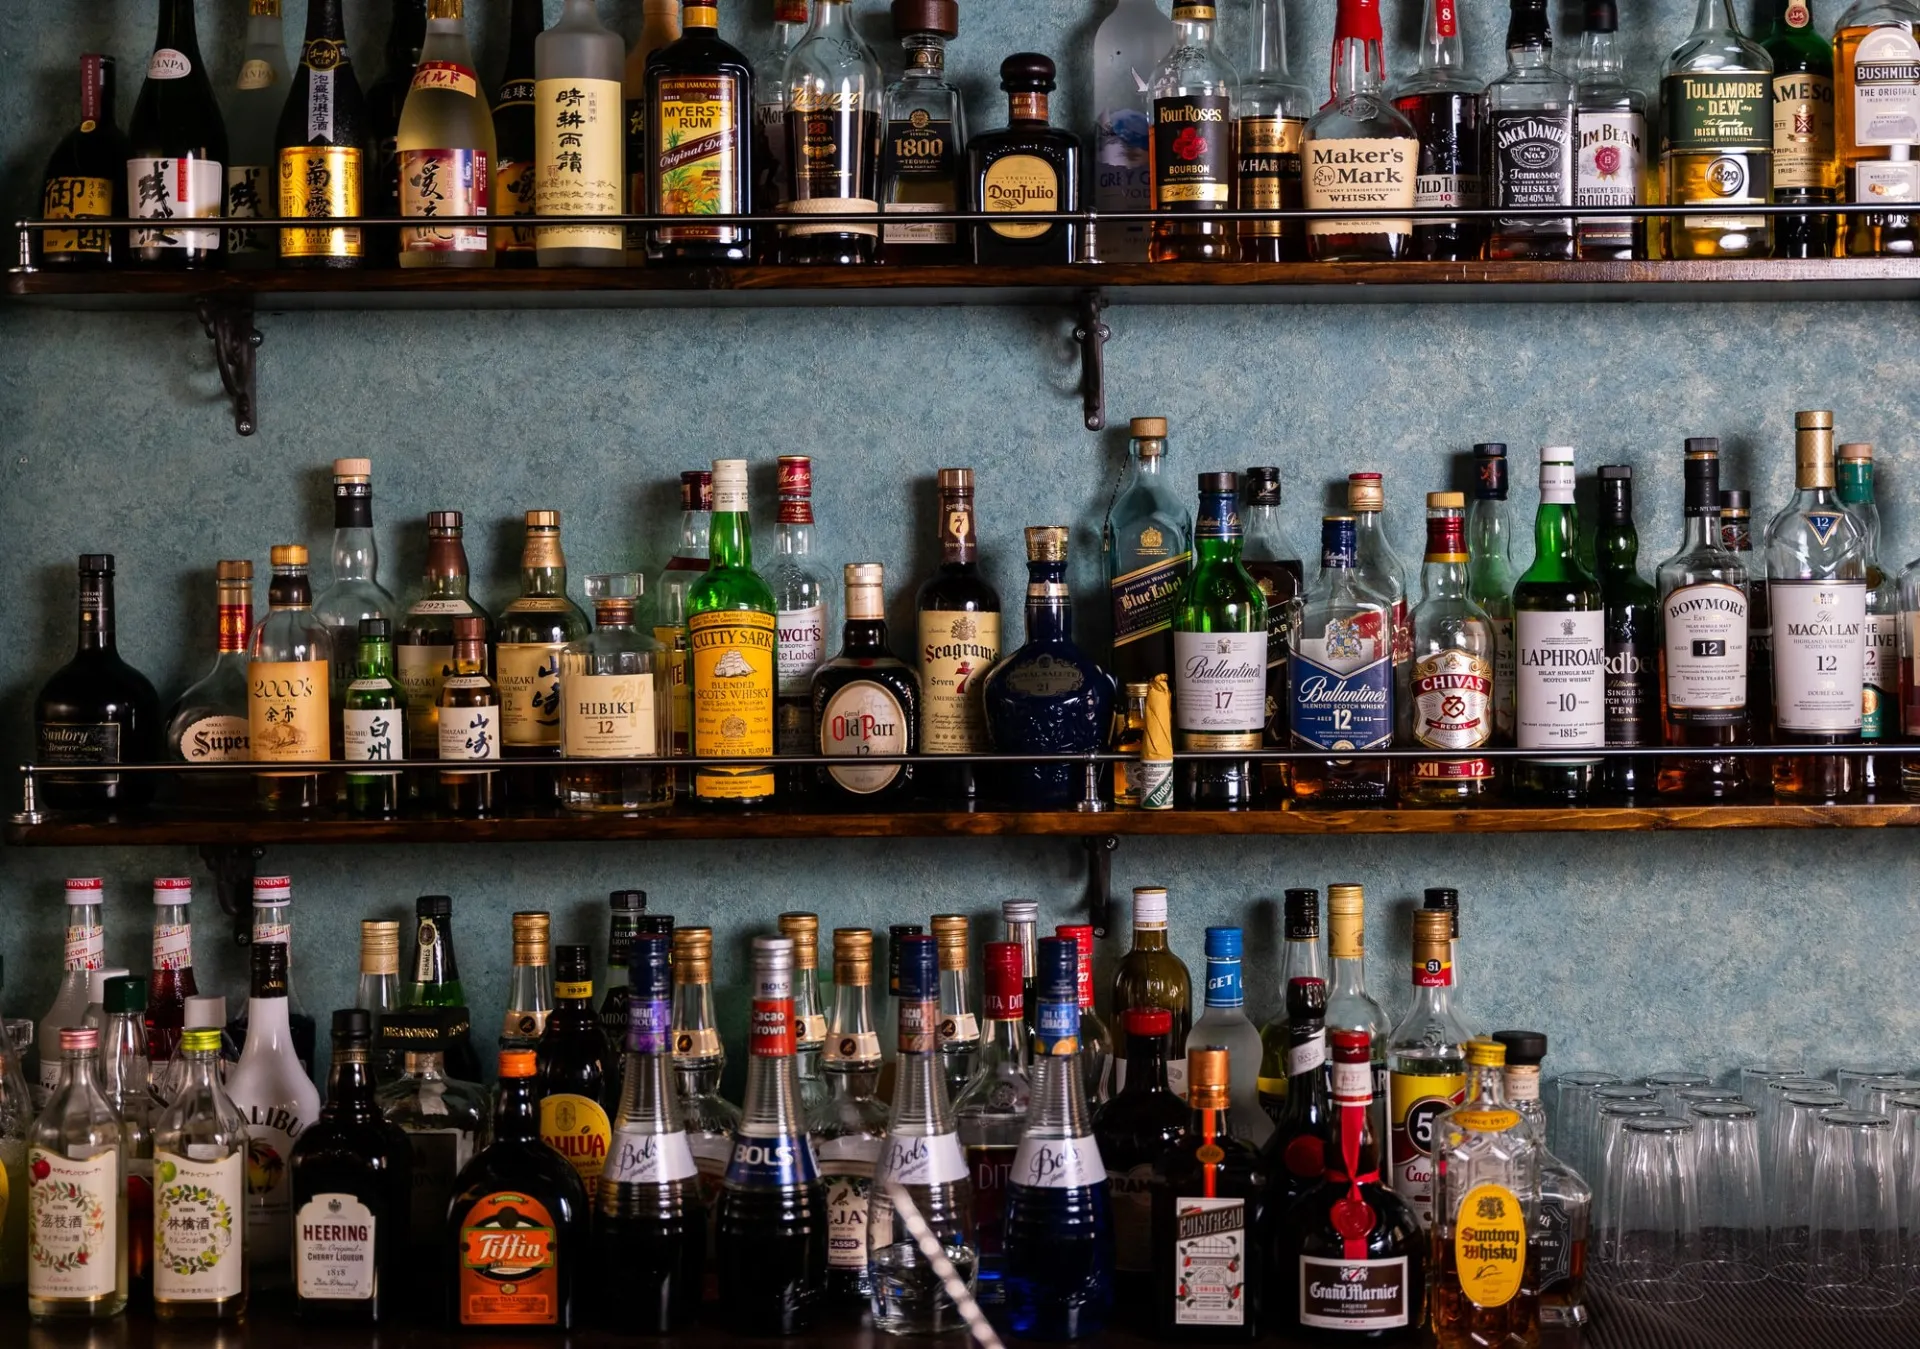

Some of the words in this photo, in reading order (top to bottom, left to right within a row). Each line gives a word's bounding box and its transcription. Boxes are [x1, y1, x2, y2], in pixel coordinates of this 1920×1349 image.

[1442, 8, 1451, 21] 8
[1857, 66, 1920, 80] BUSHMILLS
[1683, 79, 1764, 100] TULLAMORE
[1773, 82, 1832, 104] AMESO
[1860, 88, 1875, 97] THE
[1879, 88, 1917, 97] ORIGINAL
[664, 105, 731, 117] MYERS'S
[762, 107, 784, 125] Mor
[680, 117, 712, 128] RUM
[1497, 127, 1527, 149] JACK
[1527, 120, 1574, 146] DANIEL
[1602, 123, 1640, 153] BEAM
[1694, 128, 1716, 137] IRISH
[1718, 127, 1753, 137] WHISKEY
[660, 142, 703, 167] Original
[704, 137, 734, 151] Dak
[894, 138, 943, 157] 1800
[1312, 148, 1404, 165] Maker's
[1523, 151, 1547, 160] No.7
[1169, 164, 1210, 175] BOURBON
[1338, 168, 1402, 183] Mark
[1510, 168, 1560, 180] Tennessee
[1442, 177, 1482, 194] TURKE
[1511, 185, 1560, 193] WHISKEY
[1580, 187, 1608, 195] KENTUCKY
[1329, 193, 1388, 202] WHISKY
[1580, 194, 1636, 206] BOURBON
[954, 517, 965, 533] 7
[1816, 517, 1829, 527] 12
[1119, 590, 1151, 612] Blue
[1150, 576, 1183, 600] Label
[423, 602, 446, 610] 1923
[1669, 598, 1746, 619] BOWMORE
[778, 624, 821, 643] war's
[1788, 623, 1860, 636] MACALLAN
[693, 630, 737, 648] CUTTY
[739, 630, 772, 648] SARK
[789, 648, 816, 660] Label
[925, 645, 999, 663] Seagram's
[1700, 642, 1718, 655] 12
[1521, 648, 1604, 667] LAPHROAIG
[1816, 655, 1838, 672] 12
[1866, 650, 1876, 666] 2
[931, 676, 955, 686] Seven
[954, 666, 974, 694] 7
[1047, 671, 1078, 680] SALUTE
[1421, 675, 1484, 691] CHIVAS
[711, 681, 755, 689] BLENDED
[1037, 682, 1050, 692] 21
[697, 689, 727, 700] SCOTS
[730, 688, 770, 699] WHISKY
[1214, 691, 1234, 709] 17
[504, 701, 513, 711] 12
[579, 702, 635, 715] HIBIKI
[1558, 693, 1577, 712] 10
[265, 705, 297, 723] 余市
[1332, 709, 1352, 730] 12
[598, 720, 614, 734] 12
[832, 715, 860, 741] Old
[861, 714, 895, 741] Parr
[1559, 728, 1578, 738] 1815
[41, 727, 89, 744] Suntory
[367, 716, 392, 760] 白州
[1417, 762, 1439, 776] XII
[1470, 762, 1484, 776] 12
[1427, 961, 1440, 971] 51
[761, 982, 788, 990] BOLS
[1208, 974, 1234, 990] GET
[1009, 994, 1023, 1009] DIT
[600, 1012, 628, 1025] MIDO
[383, 1026, 439, 1039] DISARONNO
[755, 1025, 786, 1035] rown
[1463, 1116, 1487, 1126] since
[735, 1146, 795, 1167] BOLS
[979, 1163, 1011, 1190] DIT
[167, 1216, 210, 1231] 林檎酒
[1180, 1206, 1243, 1238] COINTREAU
[303, 1224, 368, 1242] HEERING
[1461, 1227, 1520, 1245] Suntory
[480, 1233, 541, 1260] Tiffin
[1463, 1245, 1518, 1263] Whisky
[307, 1252, 334, 1261] CHERRY
[335, 1251, 364, 1262] LIQUEUR
